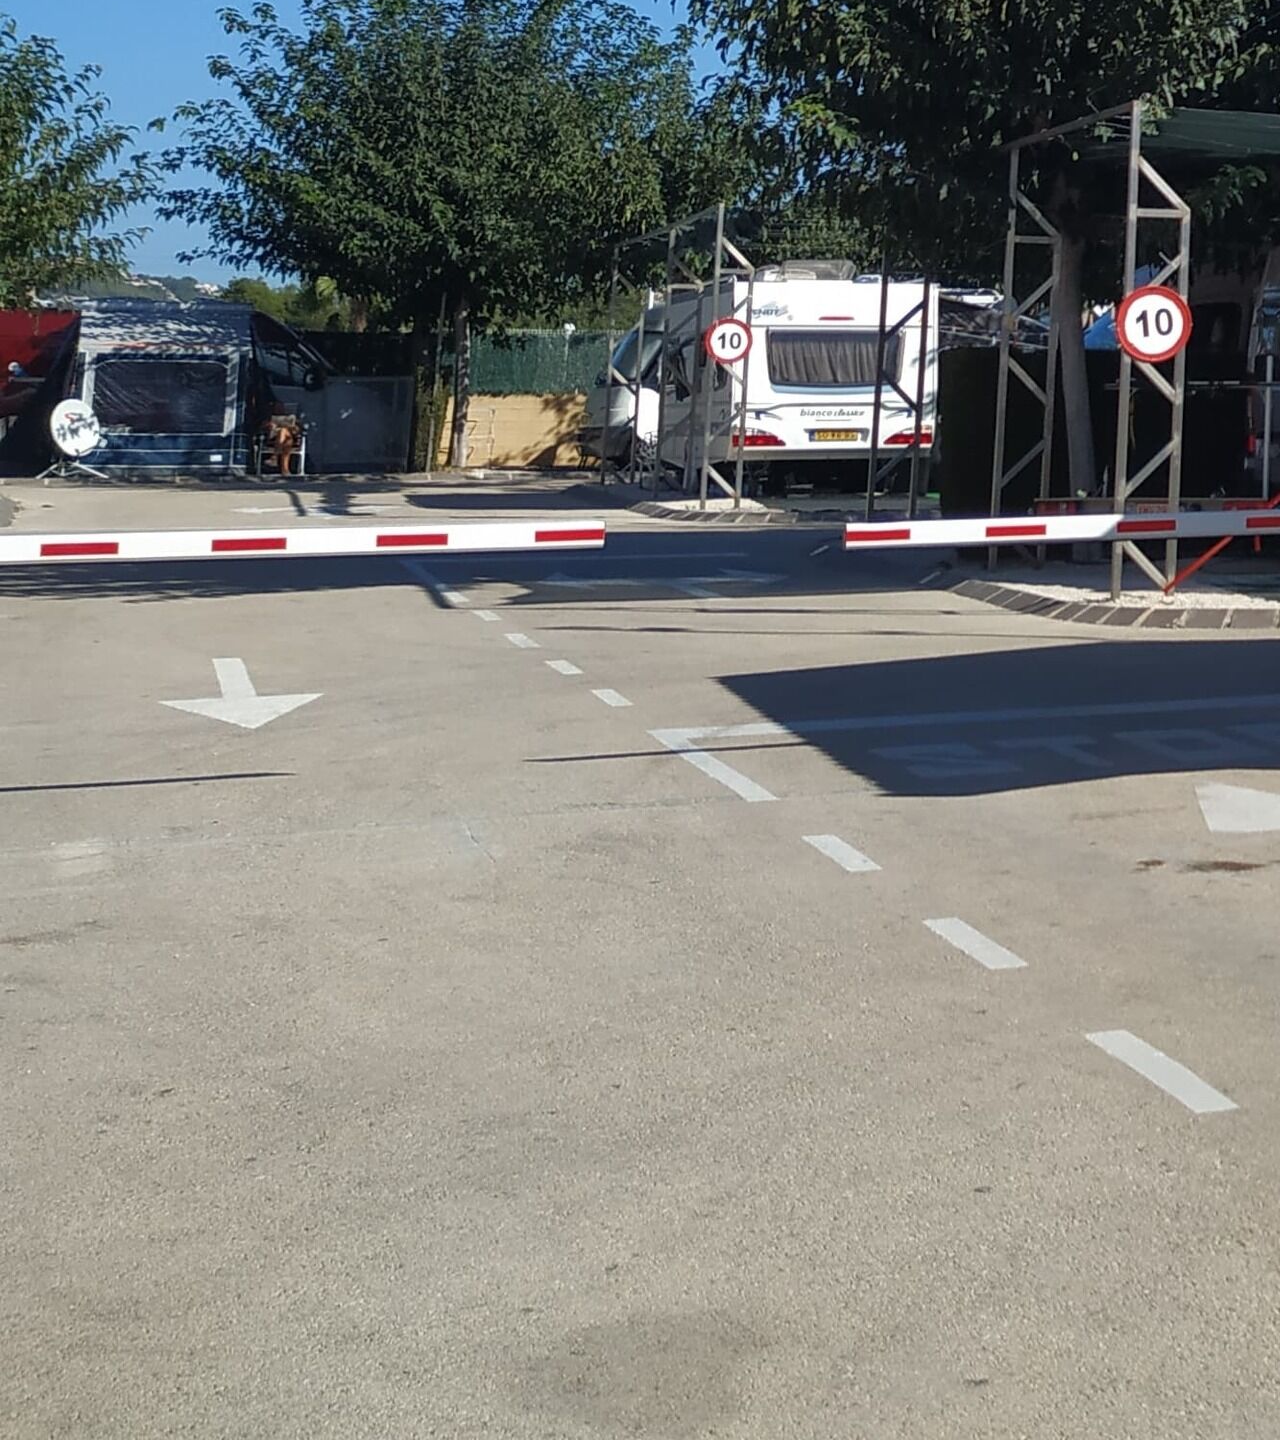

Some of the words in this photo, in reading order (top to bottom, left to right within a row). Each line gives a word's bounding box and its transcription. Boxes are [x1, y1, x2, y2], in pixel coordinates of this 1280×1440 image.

[1136, 308, 1173, 338] 10
[718, 332, 742, 349] 10
[800, 408, 833, 417] bianco
